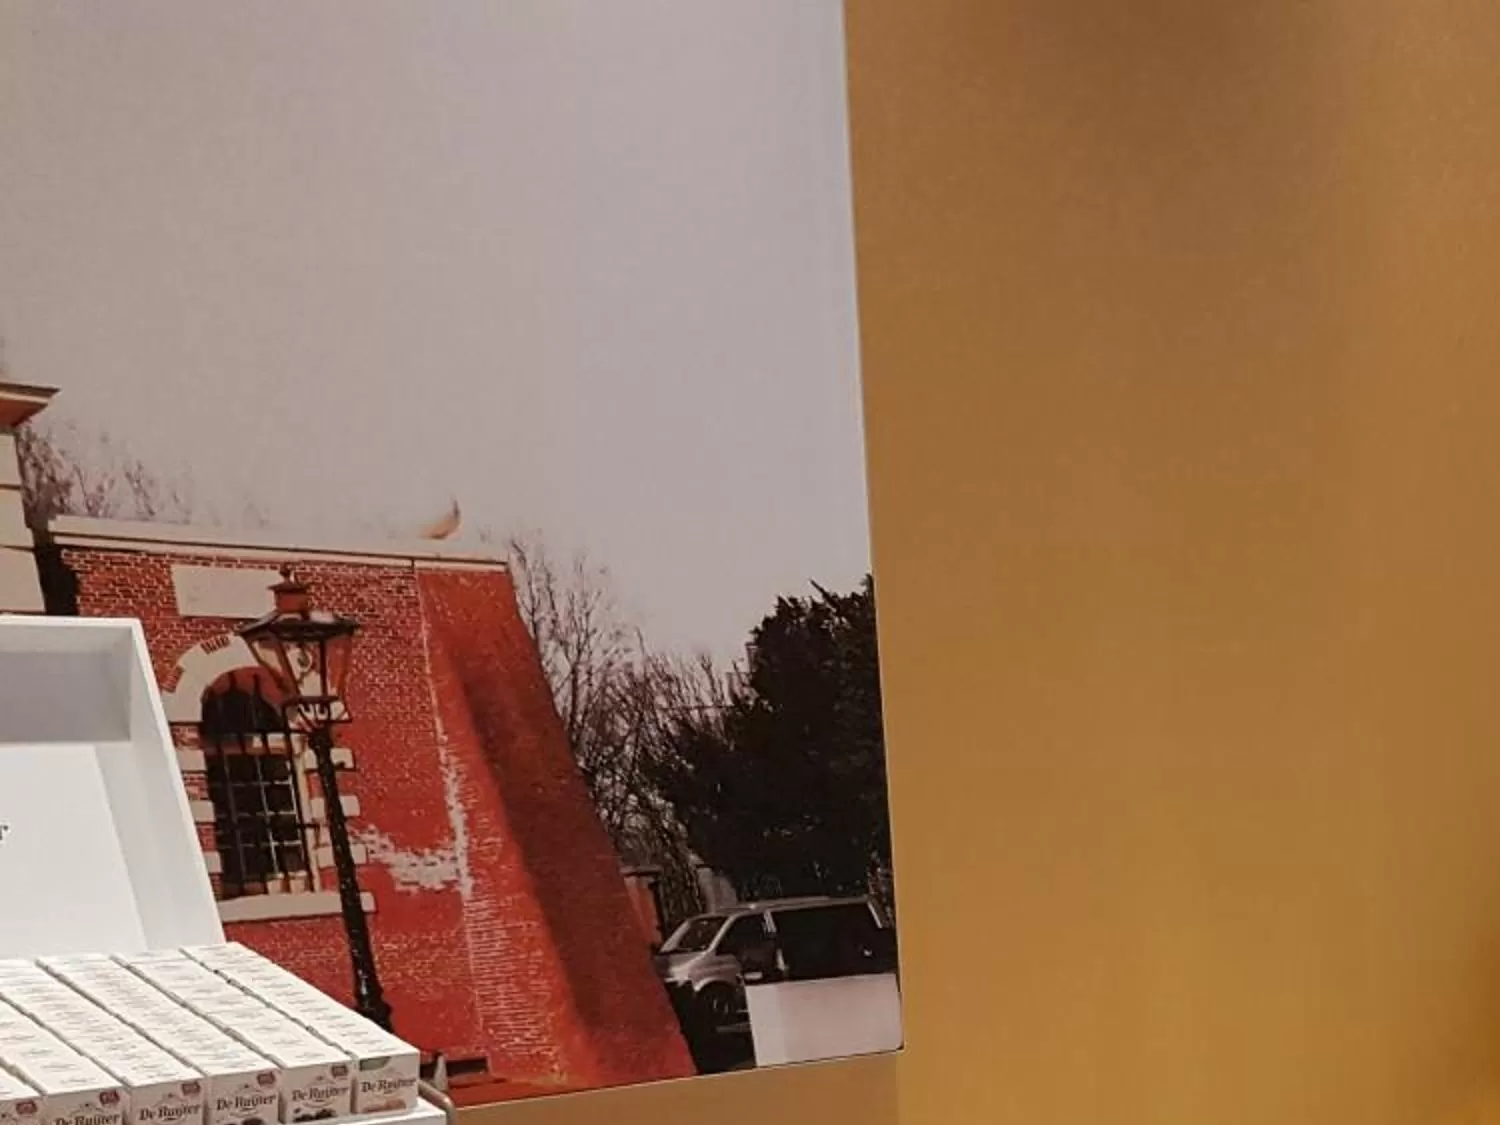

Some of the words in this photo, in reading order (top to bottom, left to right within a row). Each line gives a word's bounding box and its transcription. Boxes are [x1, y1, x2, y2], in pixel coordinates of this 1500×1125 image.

[361, 1081, 376, 1093] De
[216, 1097, 234, 1111] De
[235, 1093, 276, 1109] Ruijter
[292, 1089, 309, 1101] De
[139, 1107, 158, 1120] De
[159, 1102, 200, 1119] Ruijter
